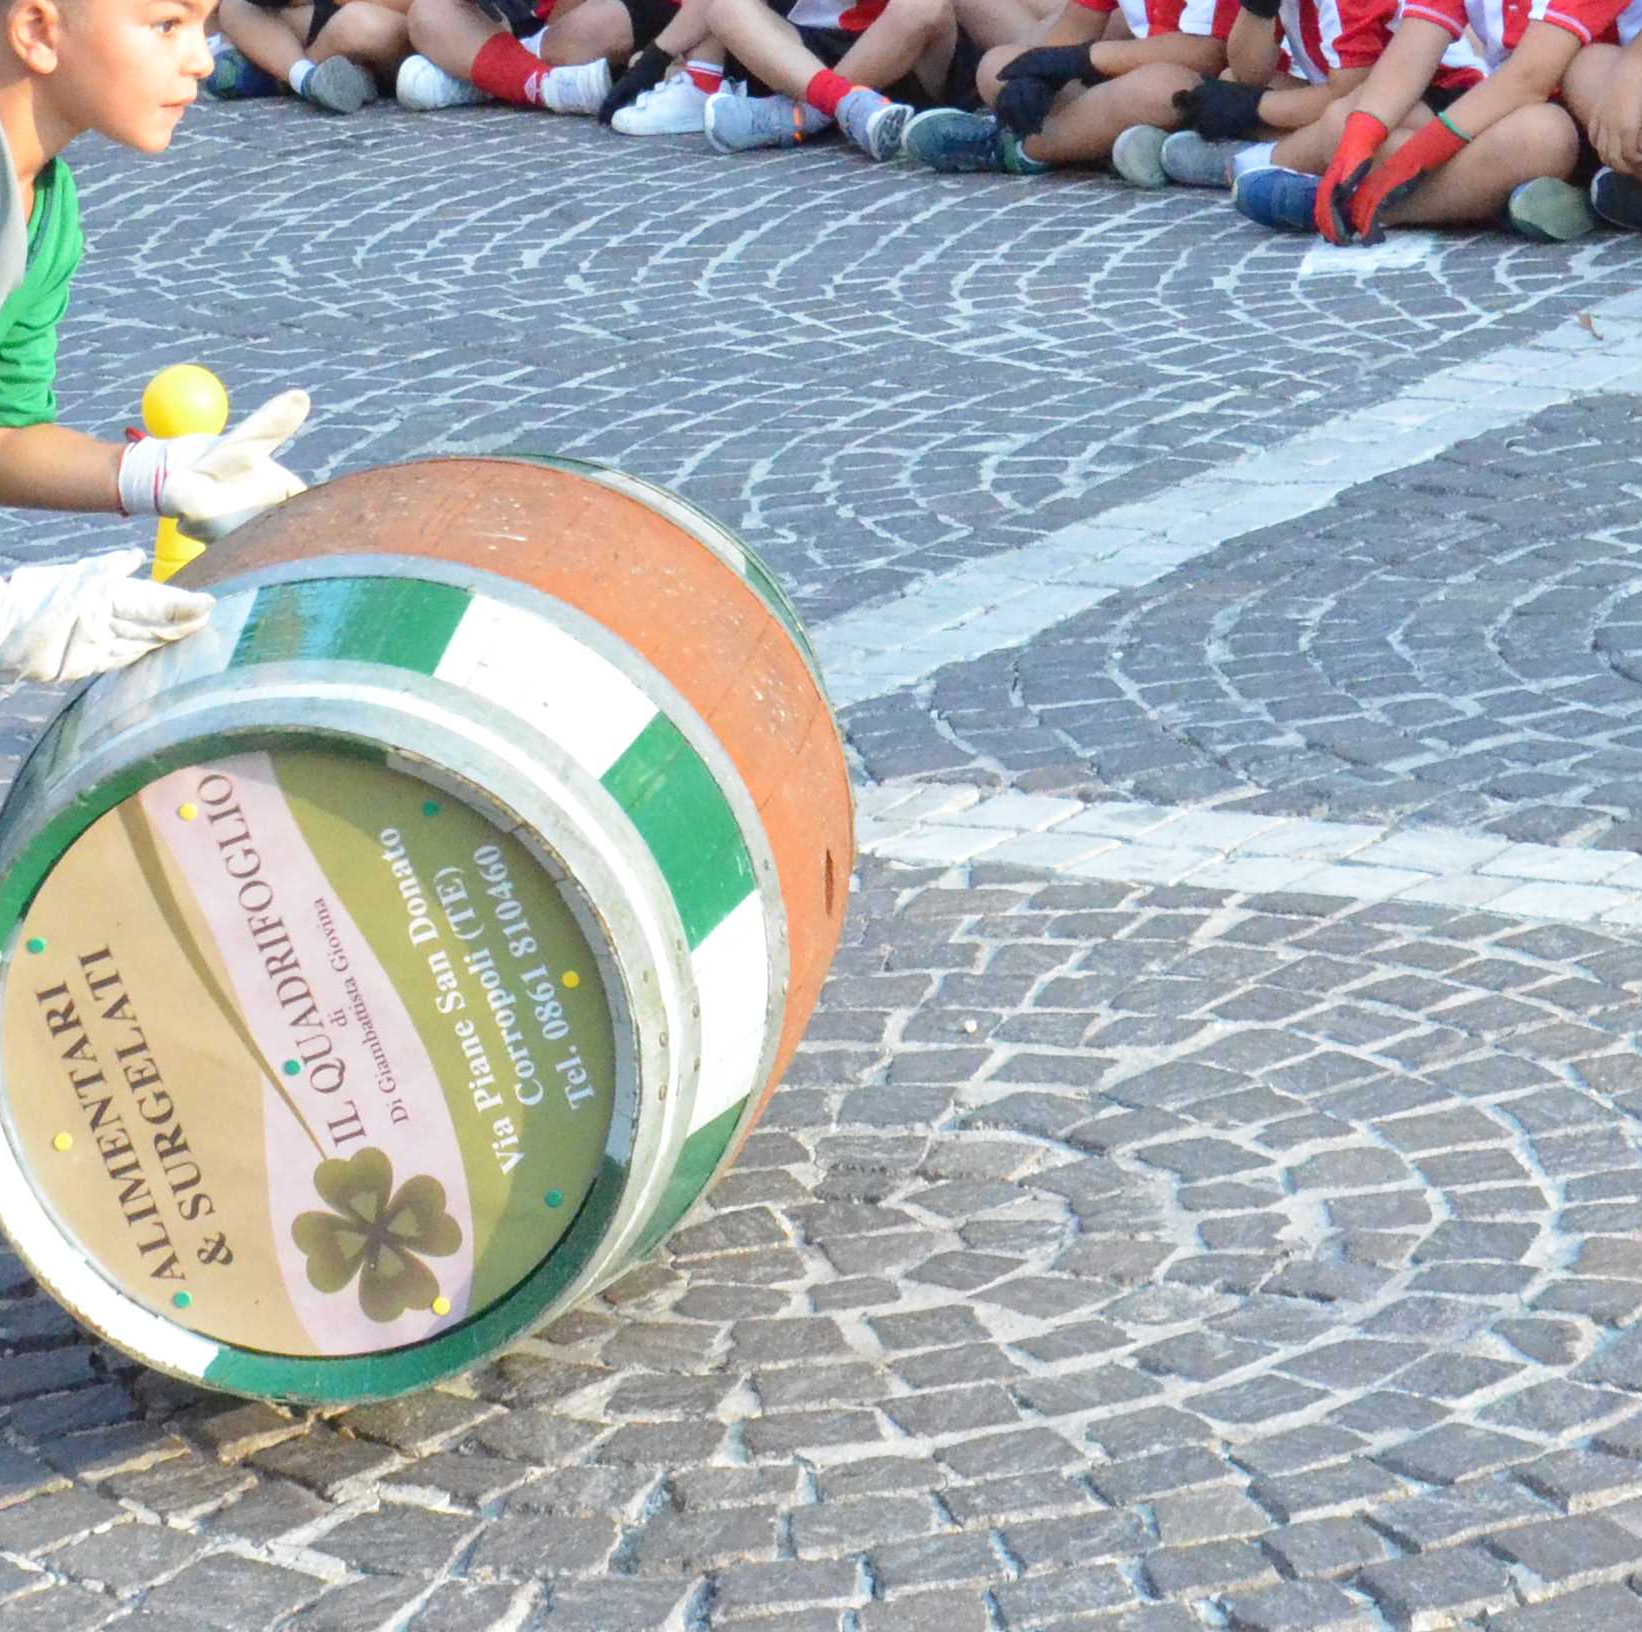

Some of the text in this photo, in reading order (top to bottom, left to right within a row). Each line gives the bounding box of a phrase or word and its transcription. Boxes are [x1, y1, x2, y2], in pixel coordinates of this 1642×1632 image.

[197, 773, 368, 1148] IL QUADRIFOGLIO
[313, 897, 410, 1125] Di Giambattista Giovina
[332, 1008, 348, 1028] di
[379, 827, 526, 1176] Via Piane San Donato
[433, 865, 545, 1107] Corropoli (TE)
[473, 844, 596, 1111] Tel. 0861 810460
[35, 979, 186, 1284] ALIMENTARI
[77, 943, 234, 1267] & SURGELATI
